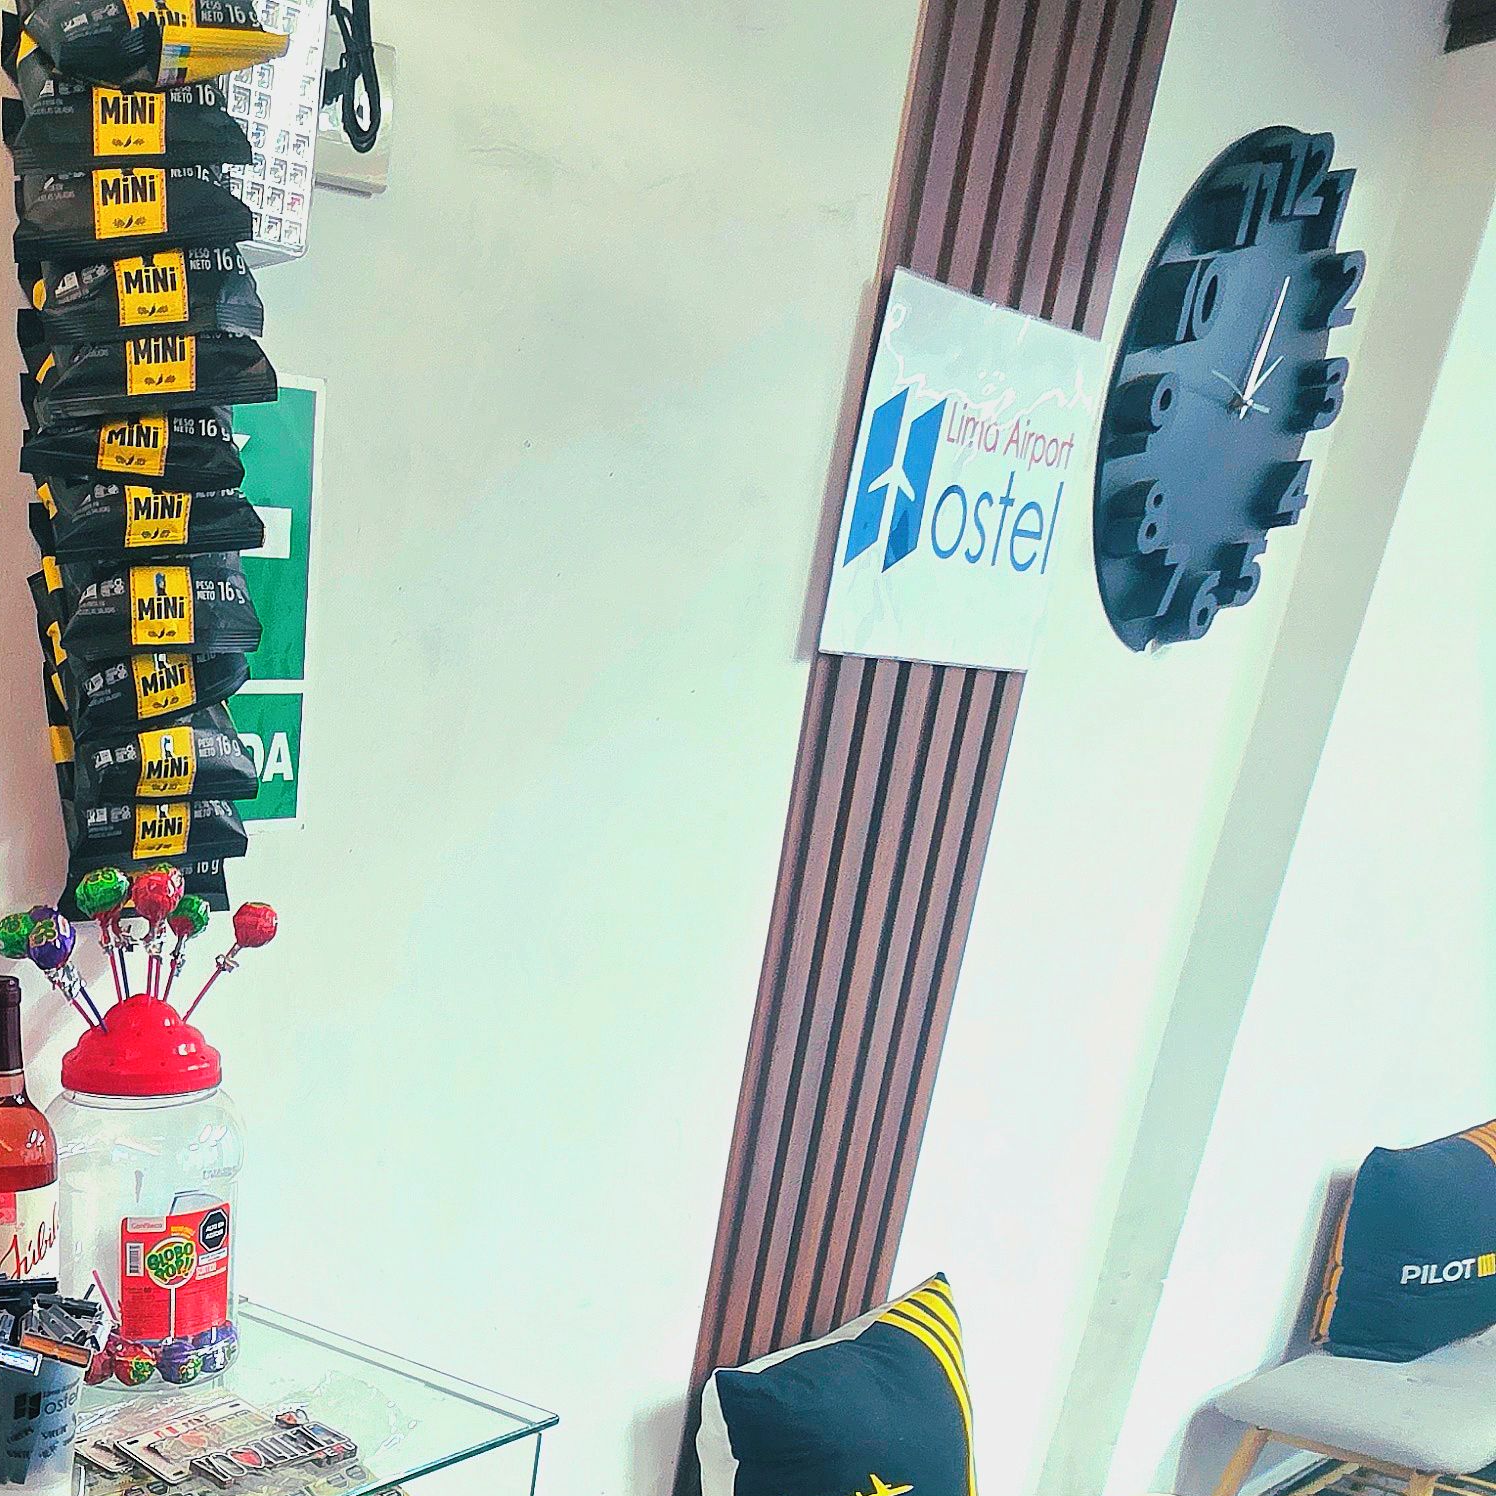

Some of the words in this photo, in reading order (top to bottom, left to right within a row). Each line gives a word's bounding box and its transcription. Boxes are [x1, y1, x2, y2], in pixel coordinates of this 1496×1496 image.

[225, 4, 246, 23] 16
[197, 84, 215, 106] 16
[190, 259, 211, 271] NETO
[213, 248, 233, 271] 16
[1175, 255, 1223, 342] 10
[1330, 251, 1367, 329] 2
[1314, 358, 1350, 431] 3
[198, 419, 218, 437] 16
[946, 403, 1000, 453] Lima
[1004, 420, 1075, 471] Airport
[1277, 460, 1312, 525] 4
[1137, 480, 1164, 554] 8
[196, 581, 215, 590] PESO
[196, 591, 215, 601] NETO
[217, 581, 234, 601] 16
[1189, 571, 1222, 638] 6
[216, 736, 232, 756] 16
[1400, 1257, 1476, 1285] PILOT
